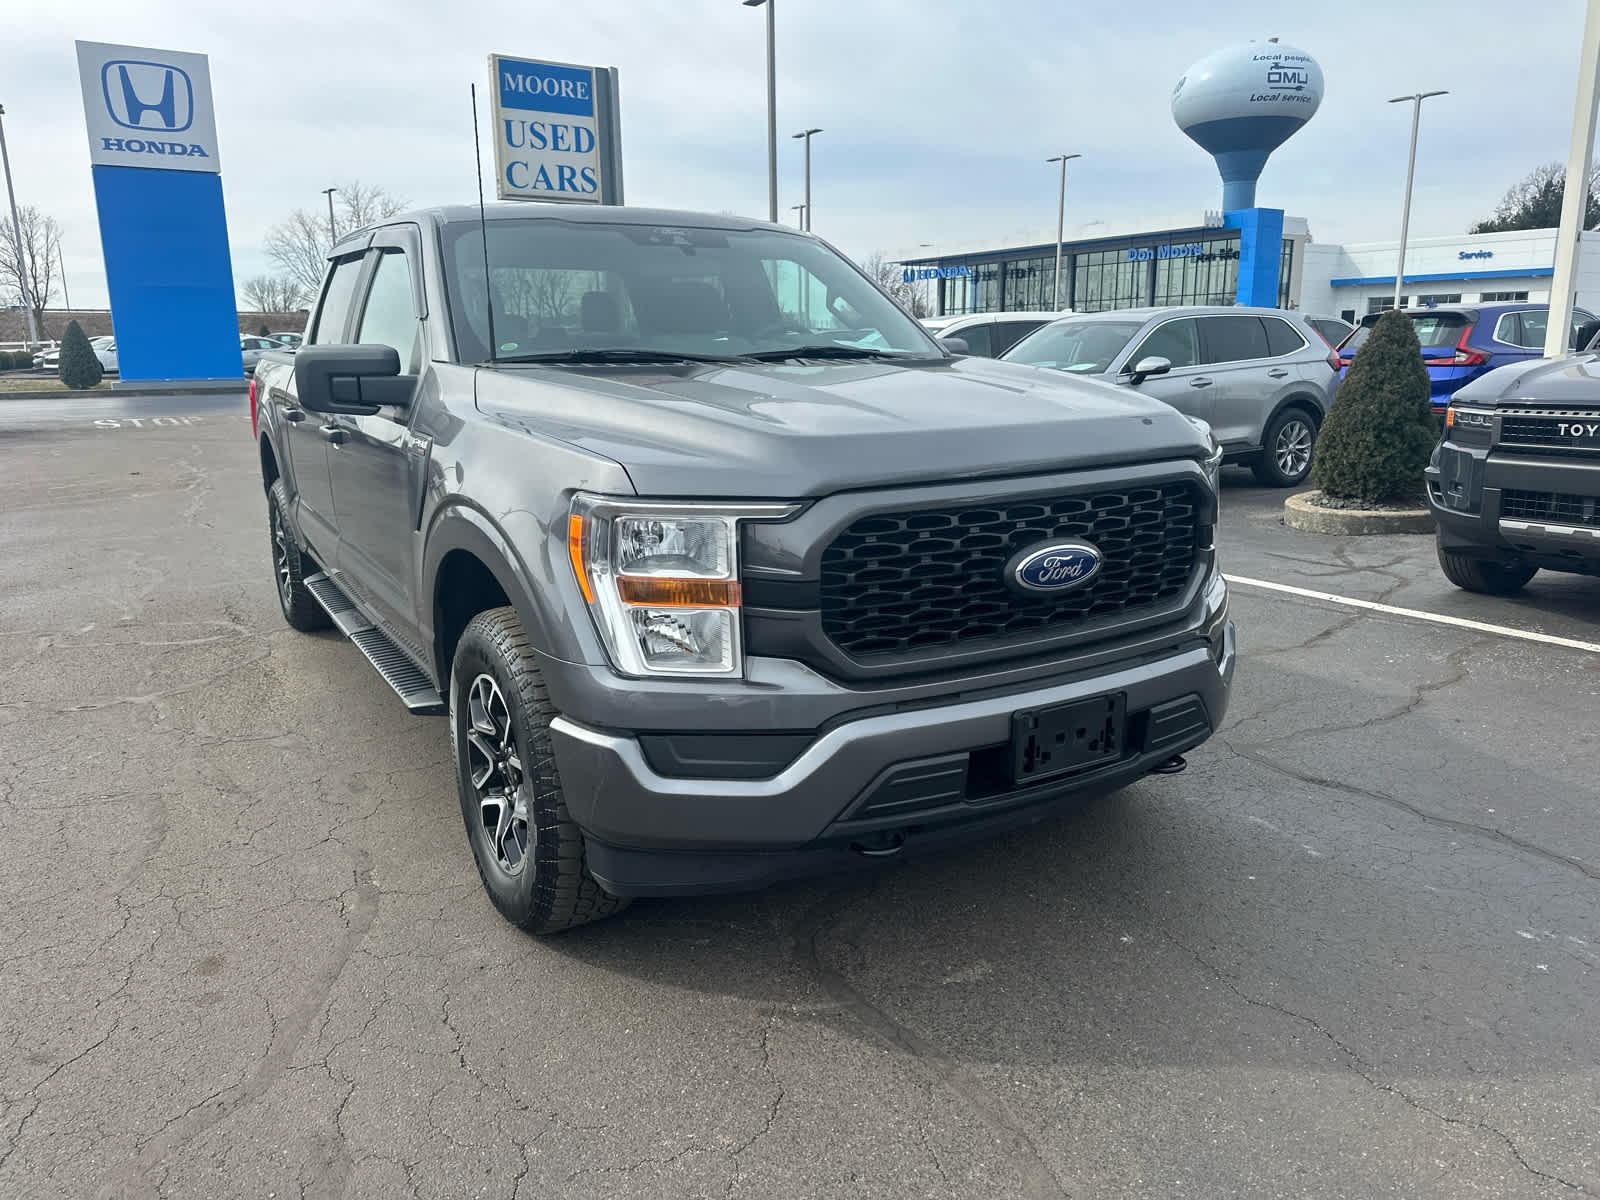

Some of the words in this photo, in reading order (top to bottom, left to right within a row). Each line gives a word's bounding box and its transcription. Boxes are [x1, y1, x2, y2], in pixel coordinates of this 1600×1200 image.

[1252, 53, 1281, 61] Local
[503, 73, 589, 100] MOORE
[1250, 92, 1281, 102] Local
[504, 119, 595, 154] USED
[101, 137, 209, 158] HONDA
[505, 160, 598, 194] CARS
[1127, 247, 1154, 261] Don
[1157, 244, 1203, 259] Moore
[1458, 249, 1494, 260] Service
[916, 265, 970, 280] HONDA
[92, 416, 207, 429] STOP
[1557, 423, 1599, 437] TOY
[1038, 555, 1085, 582] Ford
